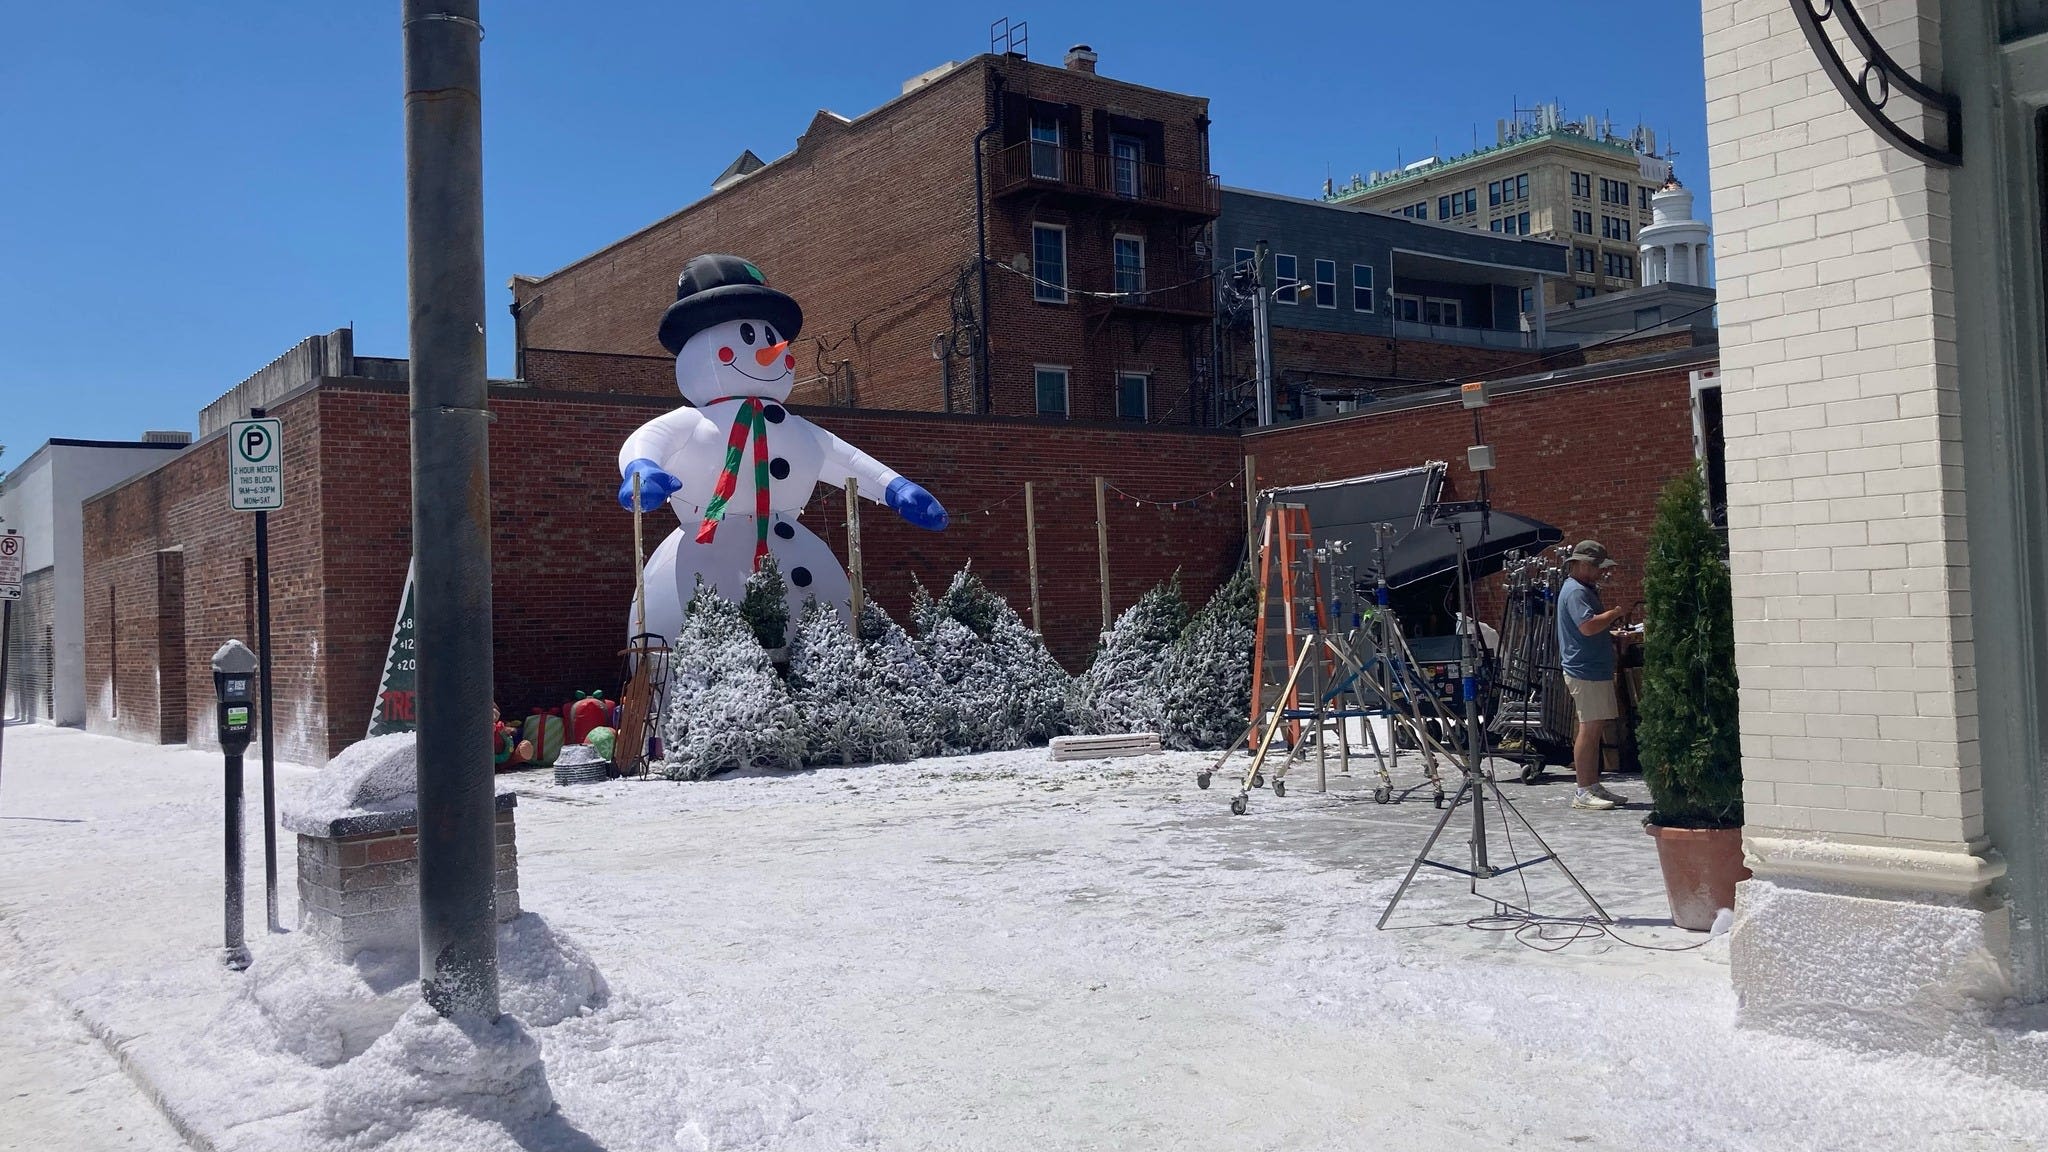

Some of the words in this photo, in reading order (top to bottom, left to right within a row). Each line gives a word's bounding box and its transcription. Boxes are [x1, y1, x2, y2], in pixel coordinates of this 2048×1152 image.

[247, 432, 264, 455] P
[239, 466, 255, 474] HOUR
[256, 465, 279, 474] METERS
[254, 476, 273, 484] BLOCK
[401, 618, 415, 629] $8
[380, 690, 416, 721] TRE
